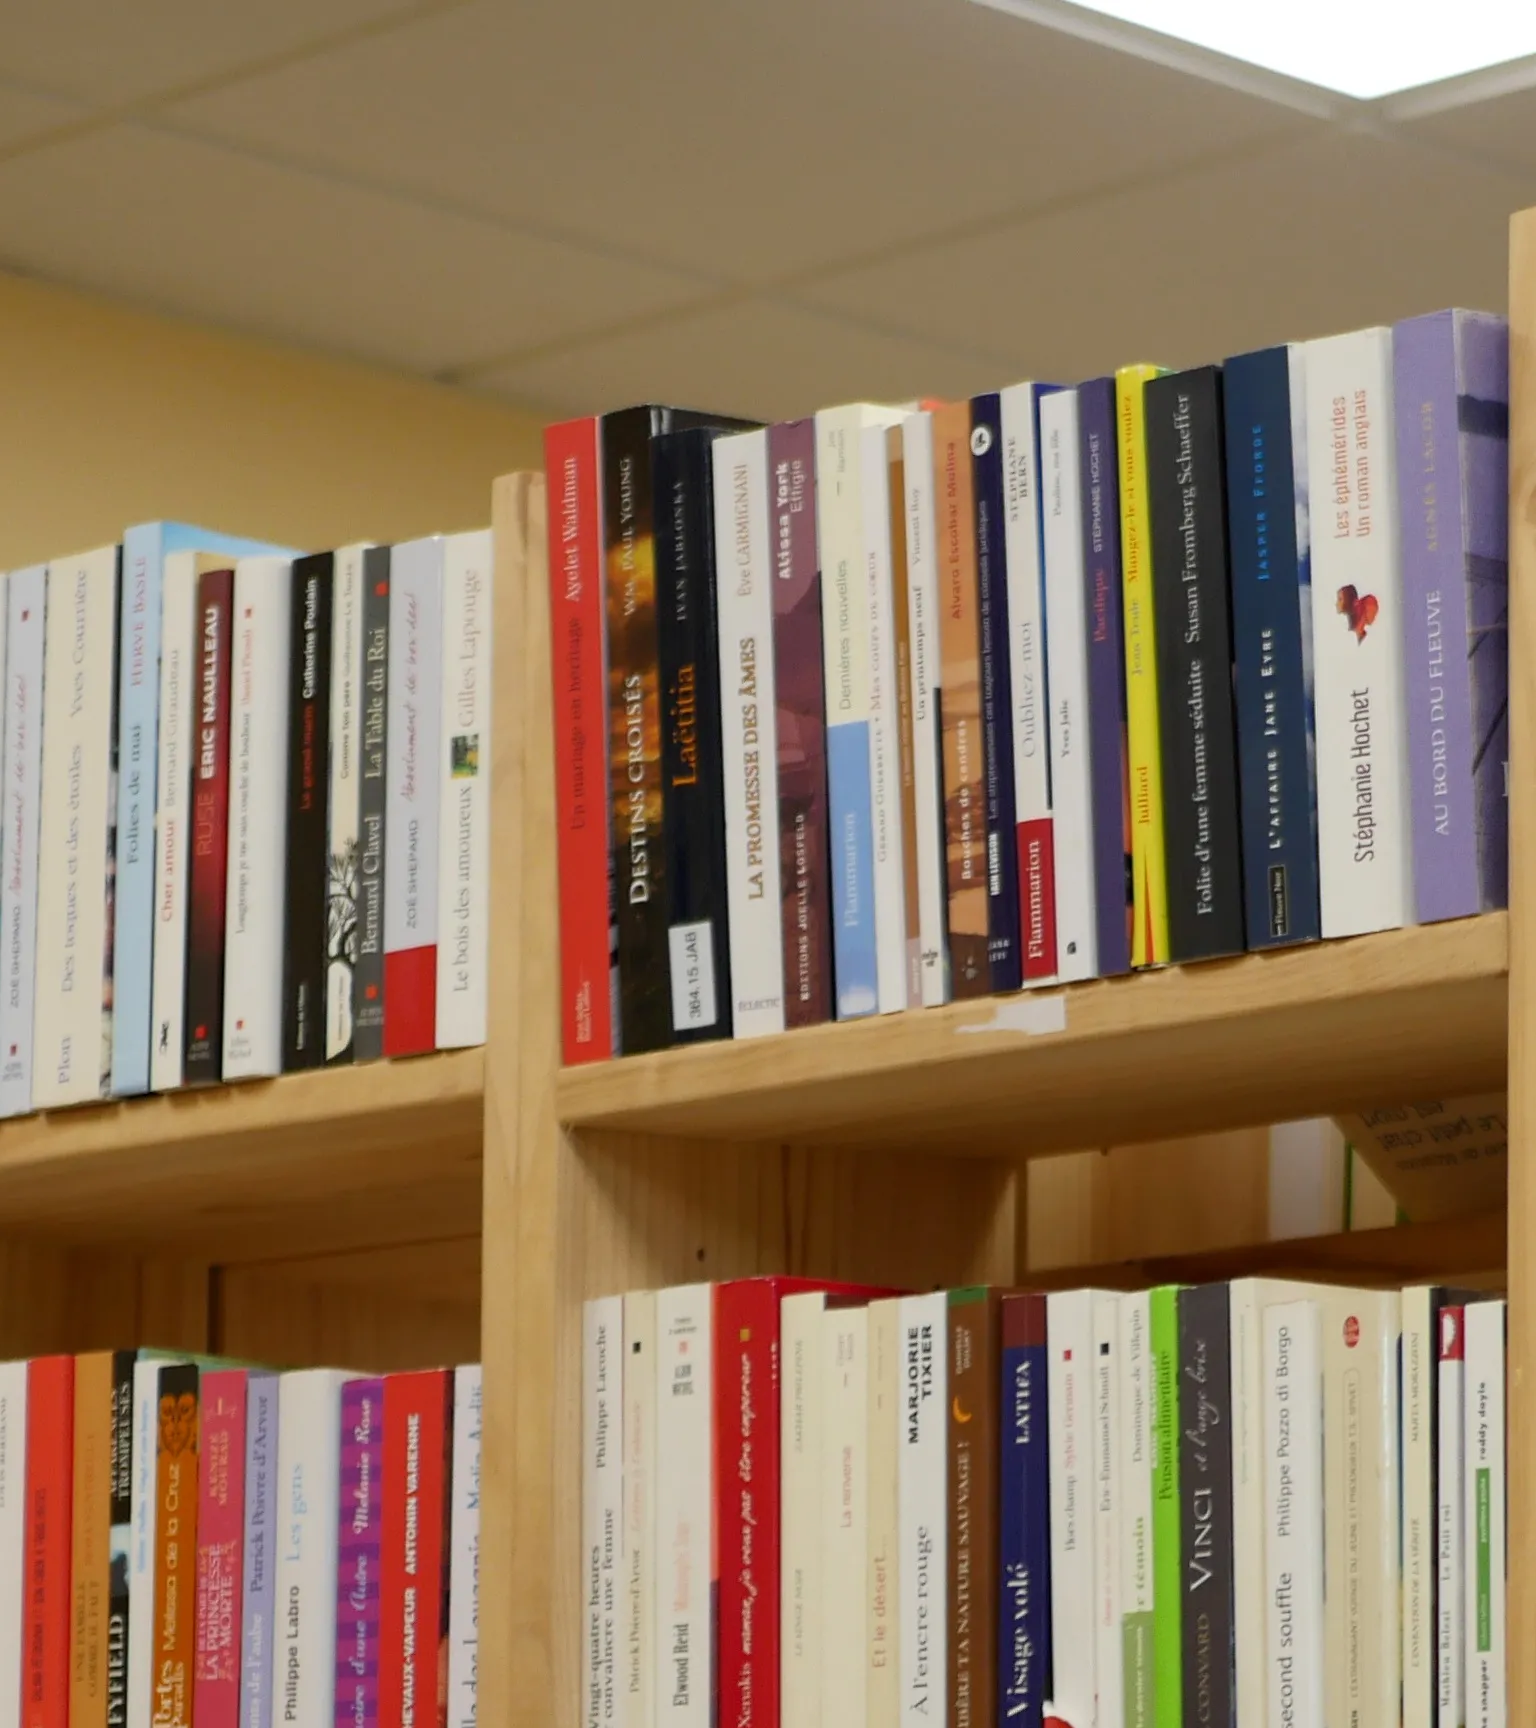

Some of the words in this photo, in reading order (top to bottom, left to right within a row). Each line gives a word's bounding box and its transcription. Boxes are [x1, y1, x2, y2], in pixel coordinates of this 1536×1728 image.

[1174, 393, 1193, 487] Schaeffer
[1183, 490, 1197, 585] Fromberg
[1185, 589, 1200, 643] Susan
[1426, 589, 1443, 681] FLEUVE
[201, 606, 219, 722] NAULLEAU
[1186, 658, 1203, 728] séduite
[627, 675, 646, 784] CROISÉS
[741, 704, 760, 745] DES
[1350, 687, 1370, 760] Hochet
[1428, 685, 1445, 720] DU
[200, 730, 215, 780] ERIC
[1192, 734, 1207, 801] femme
[1431, 727, 1447, 795] BORD
[363, 815, 380, 875] Clavel
[743, 752, 763, 868] PROMESSE
[1195, 807, 1209, 864] d'une
[1354, 764, 1374, 863] Stéphanie
[1435, 805, 1449, 836] AU
[629, 790, 649, 904] DESTINS
[361, 881, 378, 954] Bernard
[748, 871, 764, 901] LA
[1028, 839, 1043, 959] Flammarion
[1197, 867, 1212, 916] Folie
[908, 1327, 919, 1444] MARJORIE
[922, 1324, 932, 1400] TIXIER
[1276, 1327, 1291, 1377] Borgo
[1278, 1386, 1288, 1402] di
[1276, 1408, 1292, 1457] Pozzo
[1276, 1461, 1292, 1536] Philippe
[1190, 1486, 1213, 1591] VINCI
[286, 1584, 300, 1638] Labro
[1275, 1572, 1292, 1649] souffle
[284, 1641, 299, 1722] Philippe
